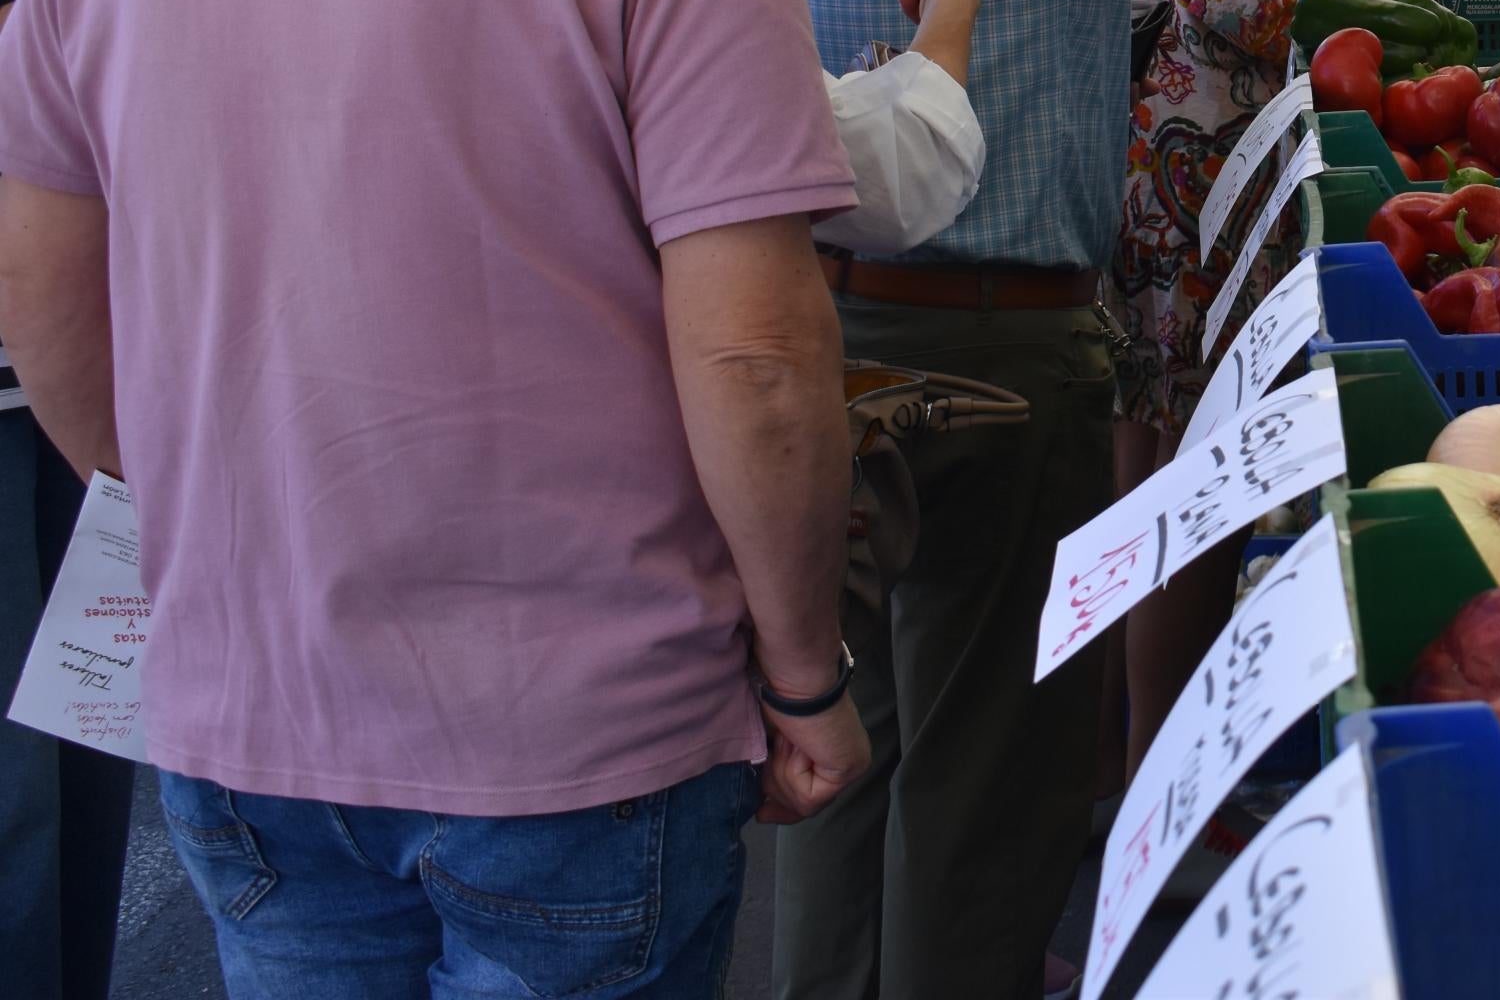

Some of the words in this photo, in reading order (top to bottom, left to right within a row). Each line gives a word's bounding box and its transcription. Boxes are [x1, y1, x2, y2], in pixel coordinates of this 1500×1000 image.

[99, 596, 150, 605] atuitas
[84, 607, 151, 618] staciones
[113, 632, 147, 643] atas
[59, 640, 135, 669] familiares
[59, 661, 111, 691] Talleres
